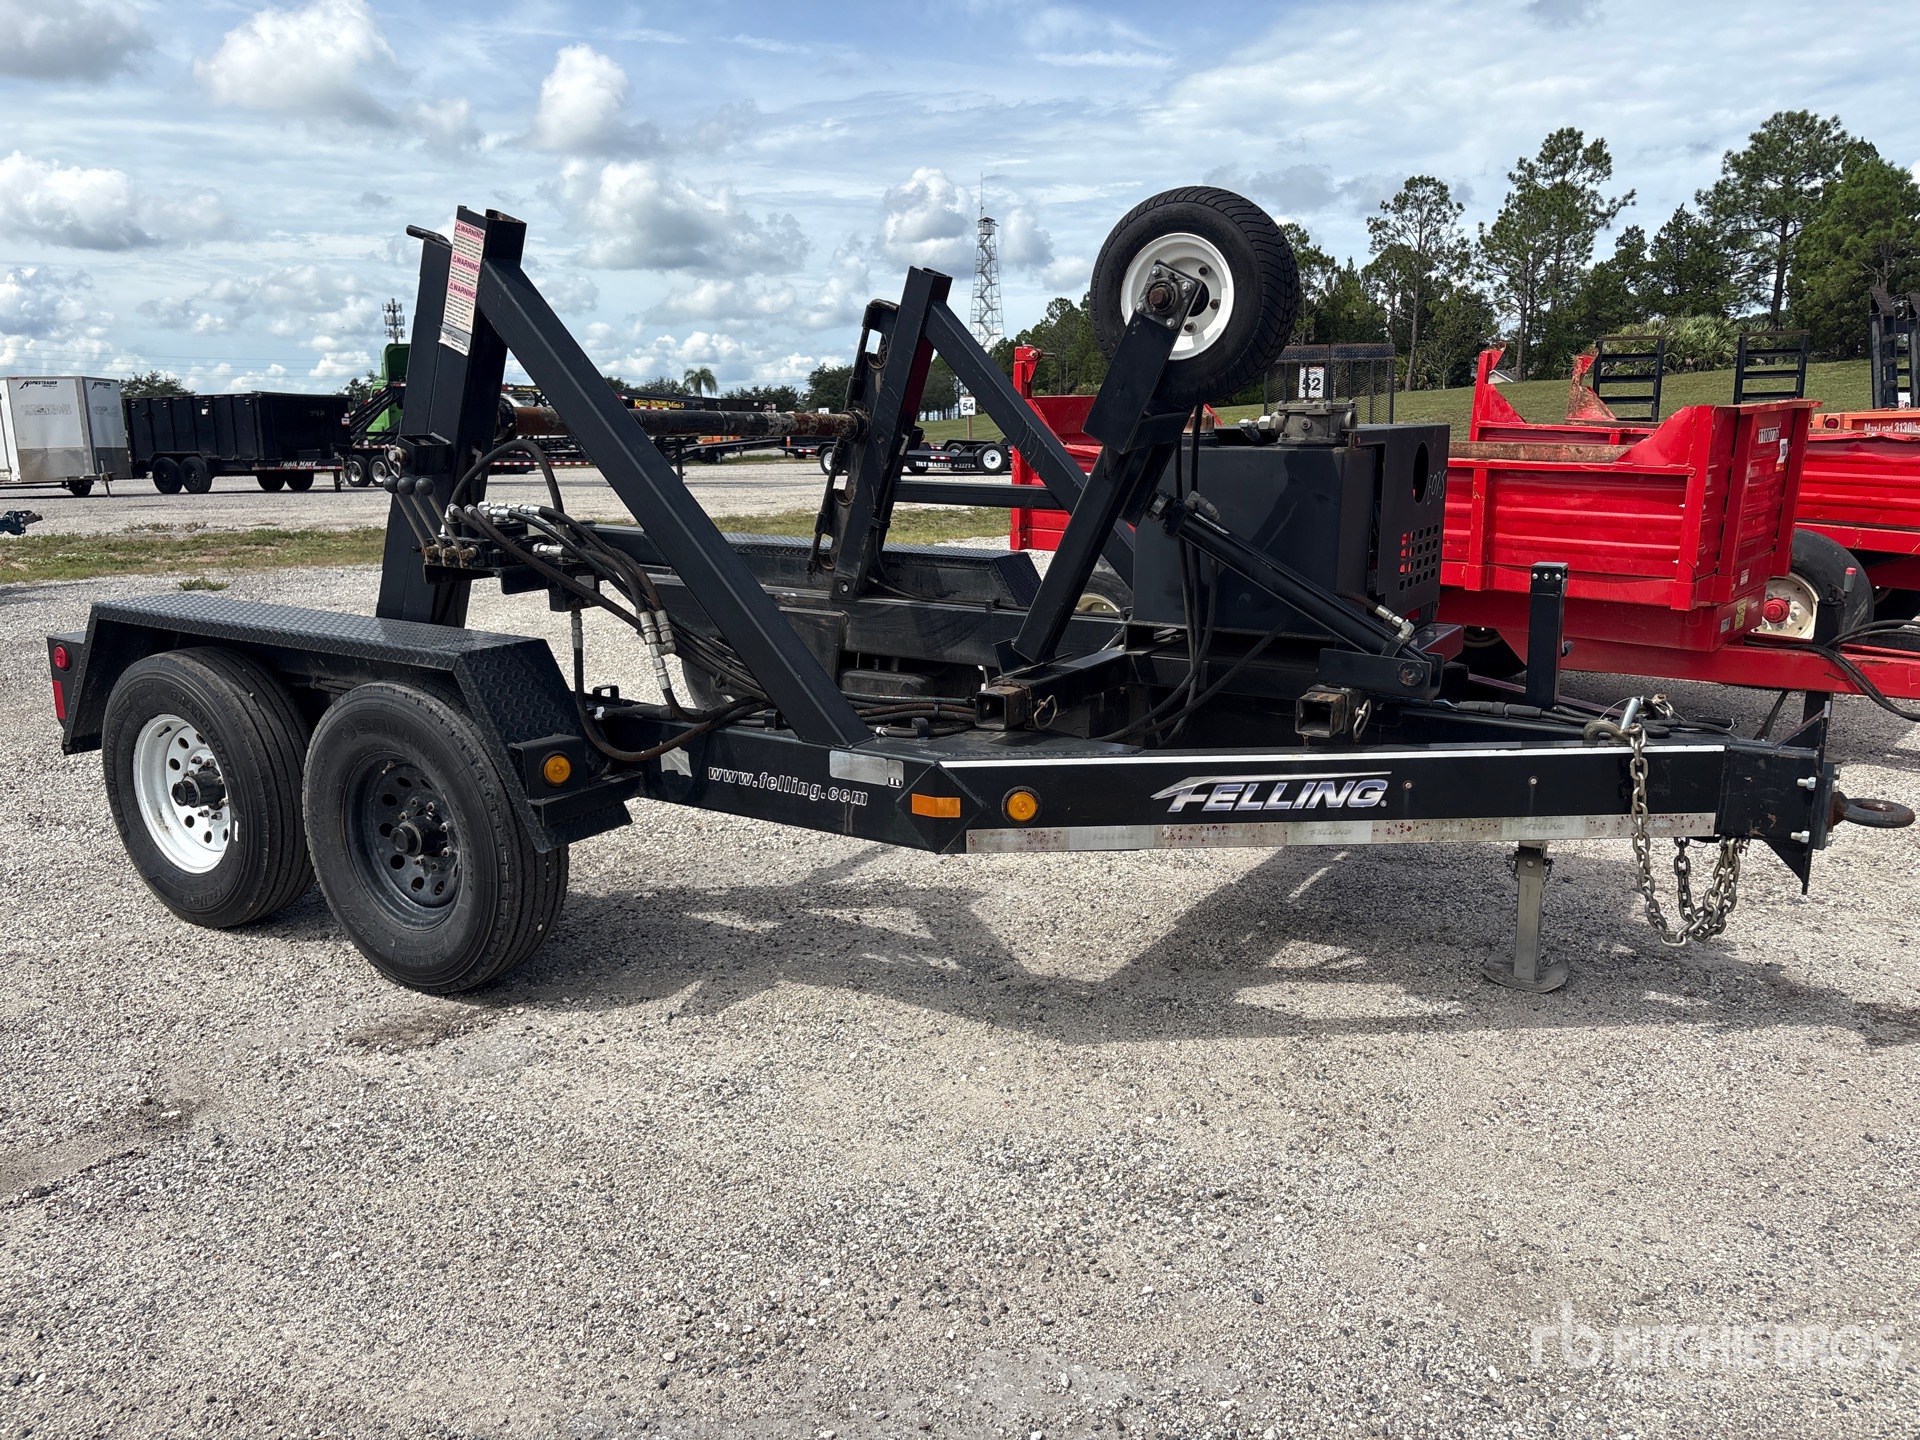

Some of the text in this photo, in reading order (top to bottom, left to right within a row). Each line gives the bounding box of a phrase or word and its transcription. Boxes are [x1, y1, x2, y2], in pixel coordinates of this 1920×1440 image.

[459, 223, 484, 240] WARNING
[456, 256, 480, 272] WARNING
[452, 284, 476, 299] WARNING
[962, 402, 974, 412] 54
[707, 765, 869, 807] www.felling.com
[1151, 774, 1390, 813] FELLING
